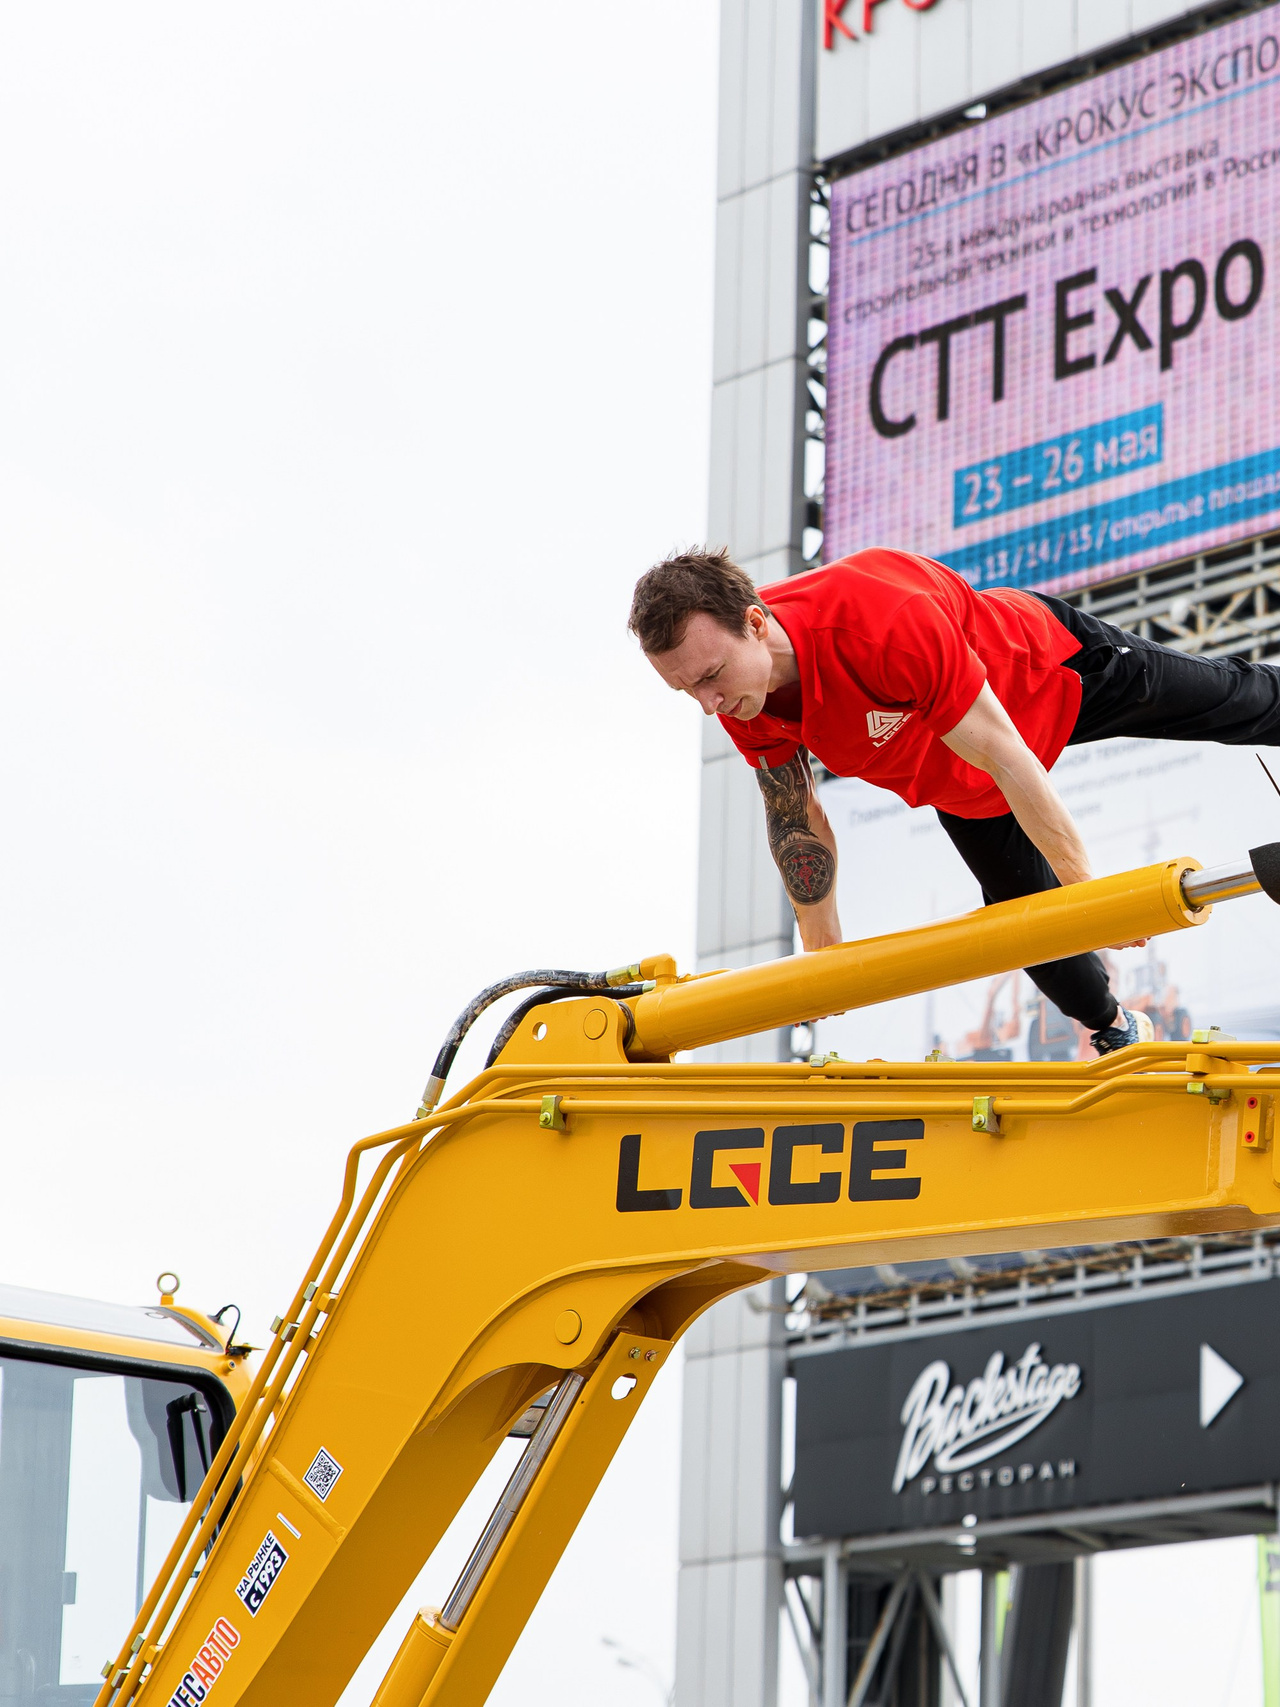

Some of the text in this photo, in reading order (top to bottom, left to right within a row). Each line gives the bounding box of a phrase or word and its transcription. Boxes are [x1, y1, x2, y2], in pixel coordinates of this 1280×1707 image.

[845, 152, 980, 234] СЕГОДНЯ
[988, 142, 1007, 180] В
[1018, 80, 1158, 168] «КРОКУС
[1124, 138, 1222, 190] выставка
[1079, 173, 1197, 236] технологий
[1053, 238, 1266, 382] Expo
[962, 465, 1003, 517] 23
[1041, 437, 1085, 491] 26
[1093, 423, 1159, 475] мая
[616, 1118, 926, 1213] LGCE
[892, 1340, 1083, 1495] Backstage
[921, 1457, 1077, 1497] РЕСТОРАН
[236, 1532, 276, 1598] НА РЫНКЕ
[253, 1550, 283, 1595] 1993
[167, 1617, 241, 1707] ЕСАВТО
